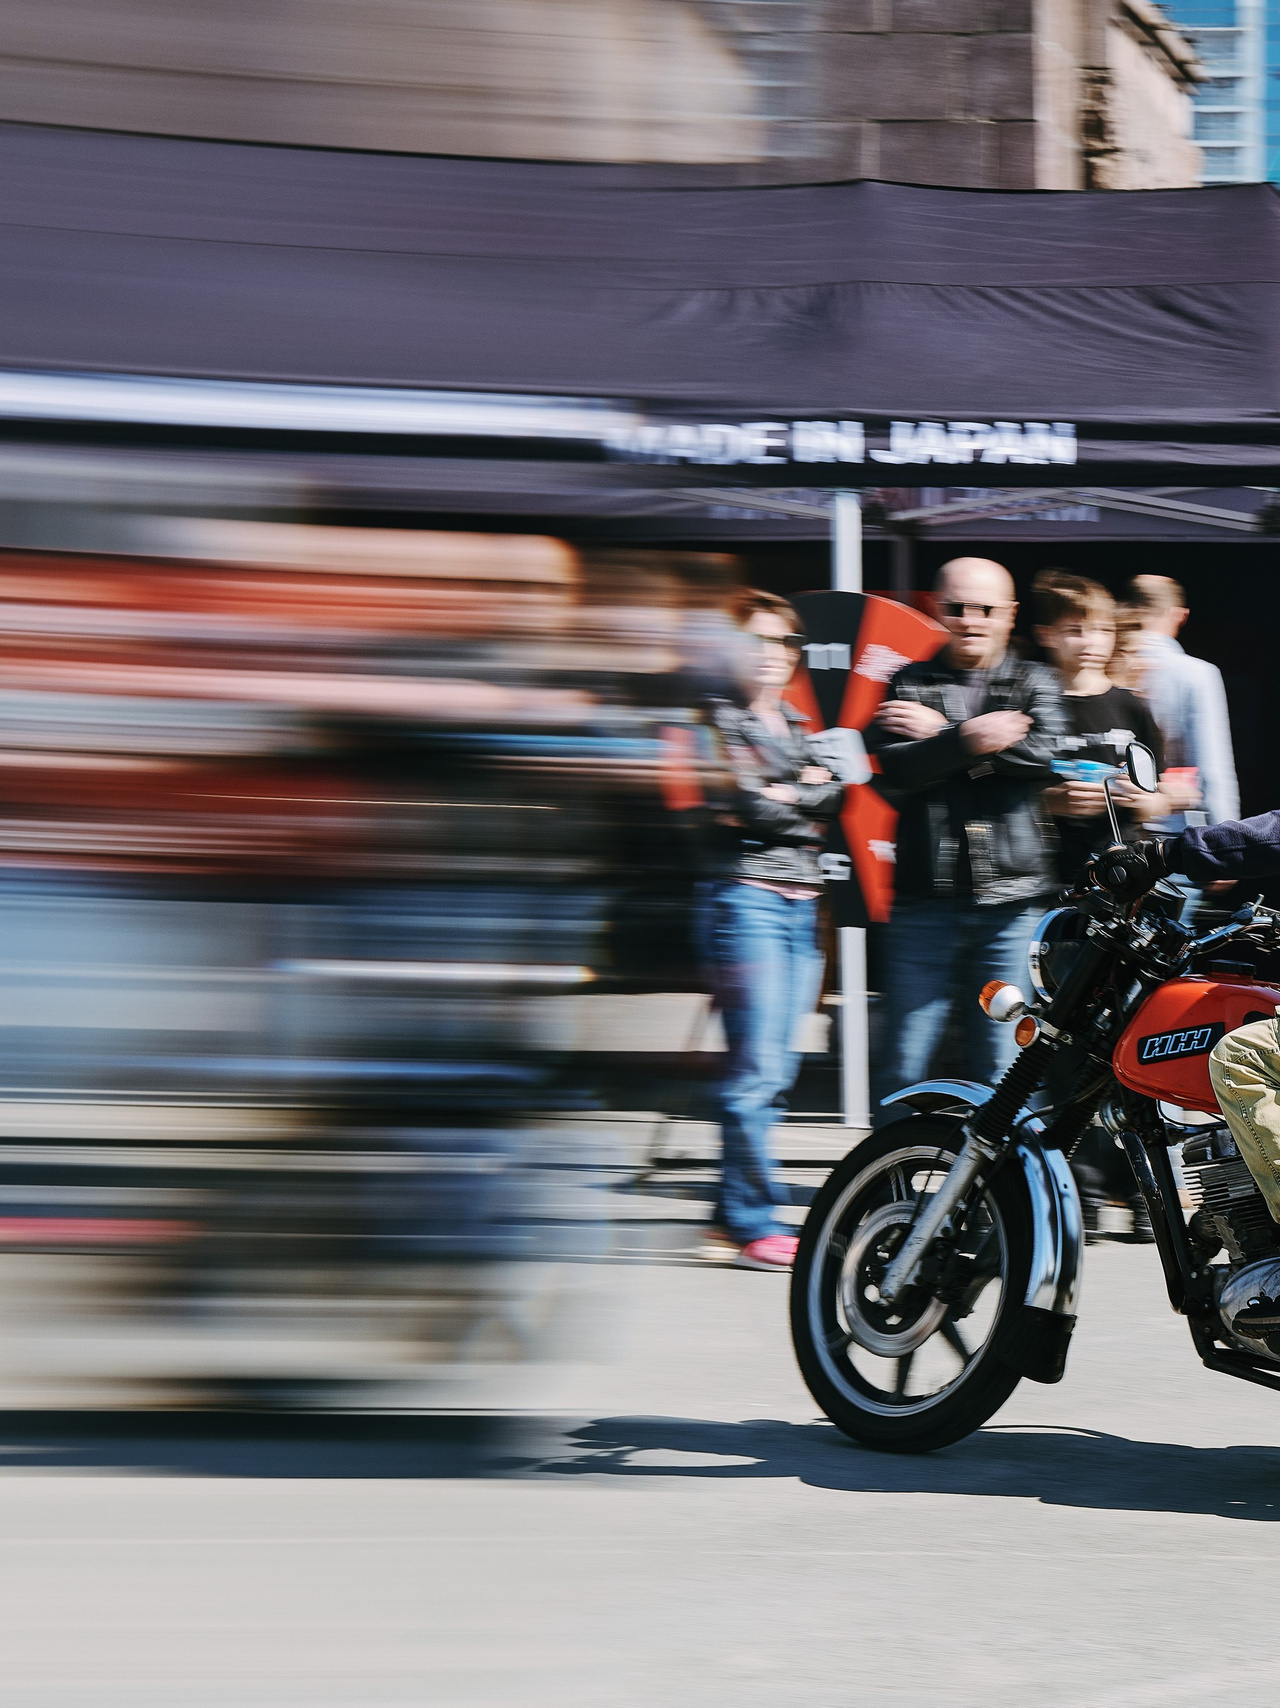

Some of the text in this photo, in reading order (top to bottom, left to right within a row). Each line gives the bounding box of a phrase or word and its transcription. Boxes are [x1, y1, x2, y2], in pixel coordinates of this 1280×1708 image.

[602, 420, 1078, 465] MADE IN JAPAN
